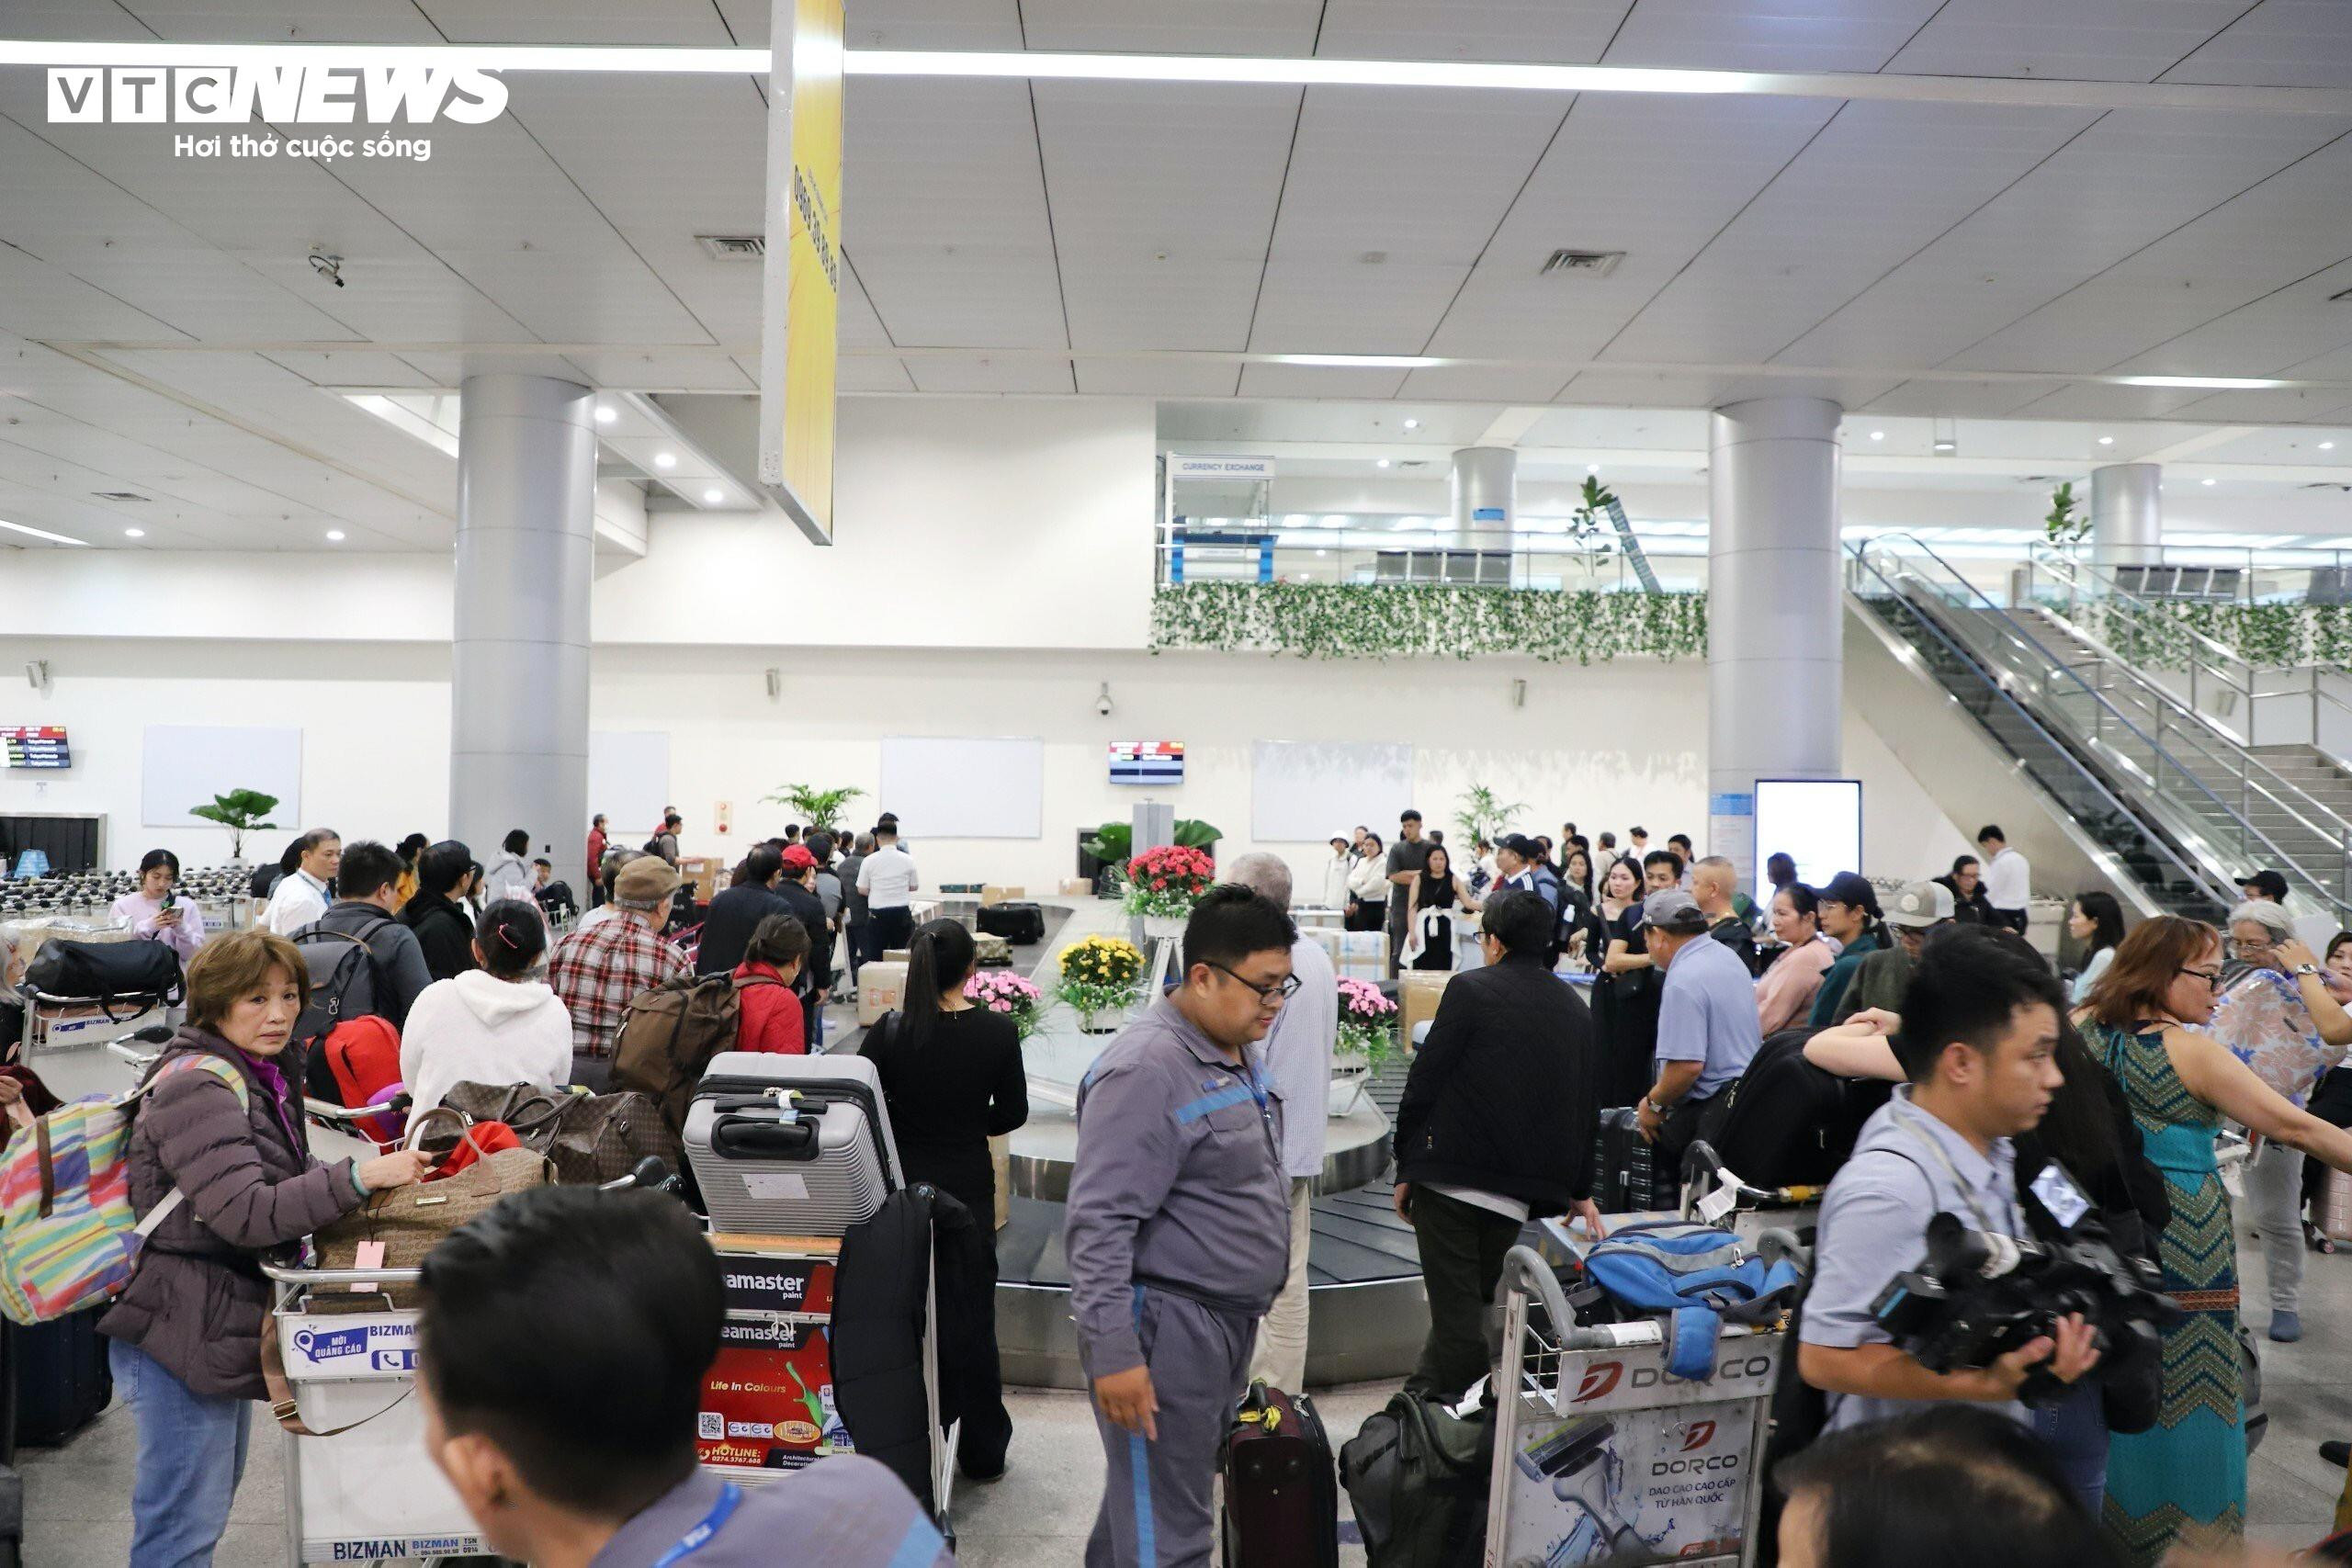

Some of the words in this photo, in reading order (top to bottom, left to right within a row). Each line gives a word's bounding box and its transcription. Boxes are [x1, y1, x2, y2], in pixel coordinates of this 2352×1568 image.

[1182, 462, 1223, 471] CURRENCY
[1225, 463, 1265, 471] EXCHANGE
[723, 1273, 805, 1292] amaster
[783, 1292, 803, 1300] paint
[720, 1325, 797, 1341] eamaster
[710, 1381, 729, 1392] Life
[731, 1382, 741, 1392] In
[744, 1382, 787, 1393] Colours
[711, 1446, 762, 1458] HOTLINE:
[1651, 1454, 1738, 1476] DORCO
[1649, 1485, 1670, 1496] DAO
[334, 1540, 406, 1560] BIZMAN
[412, 1539, 458, 1550] BIZMAN
